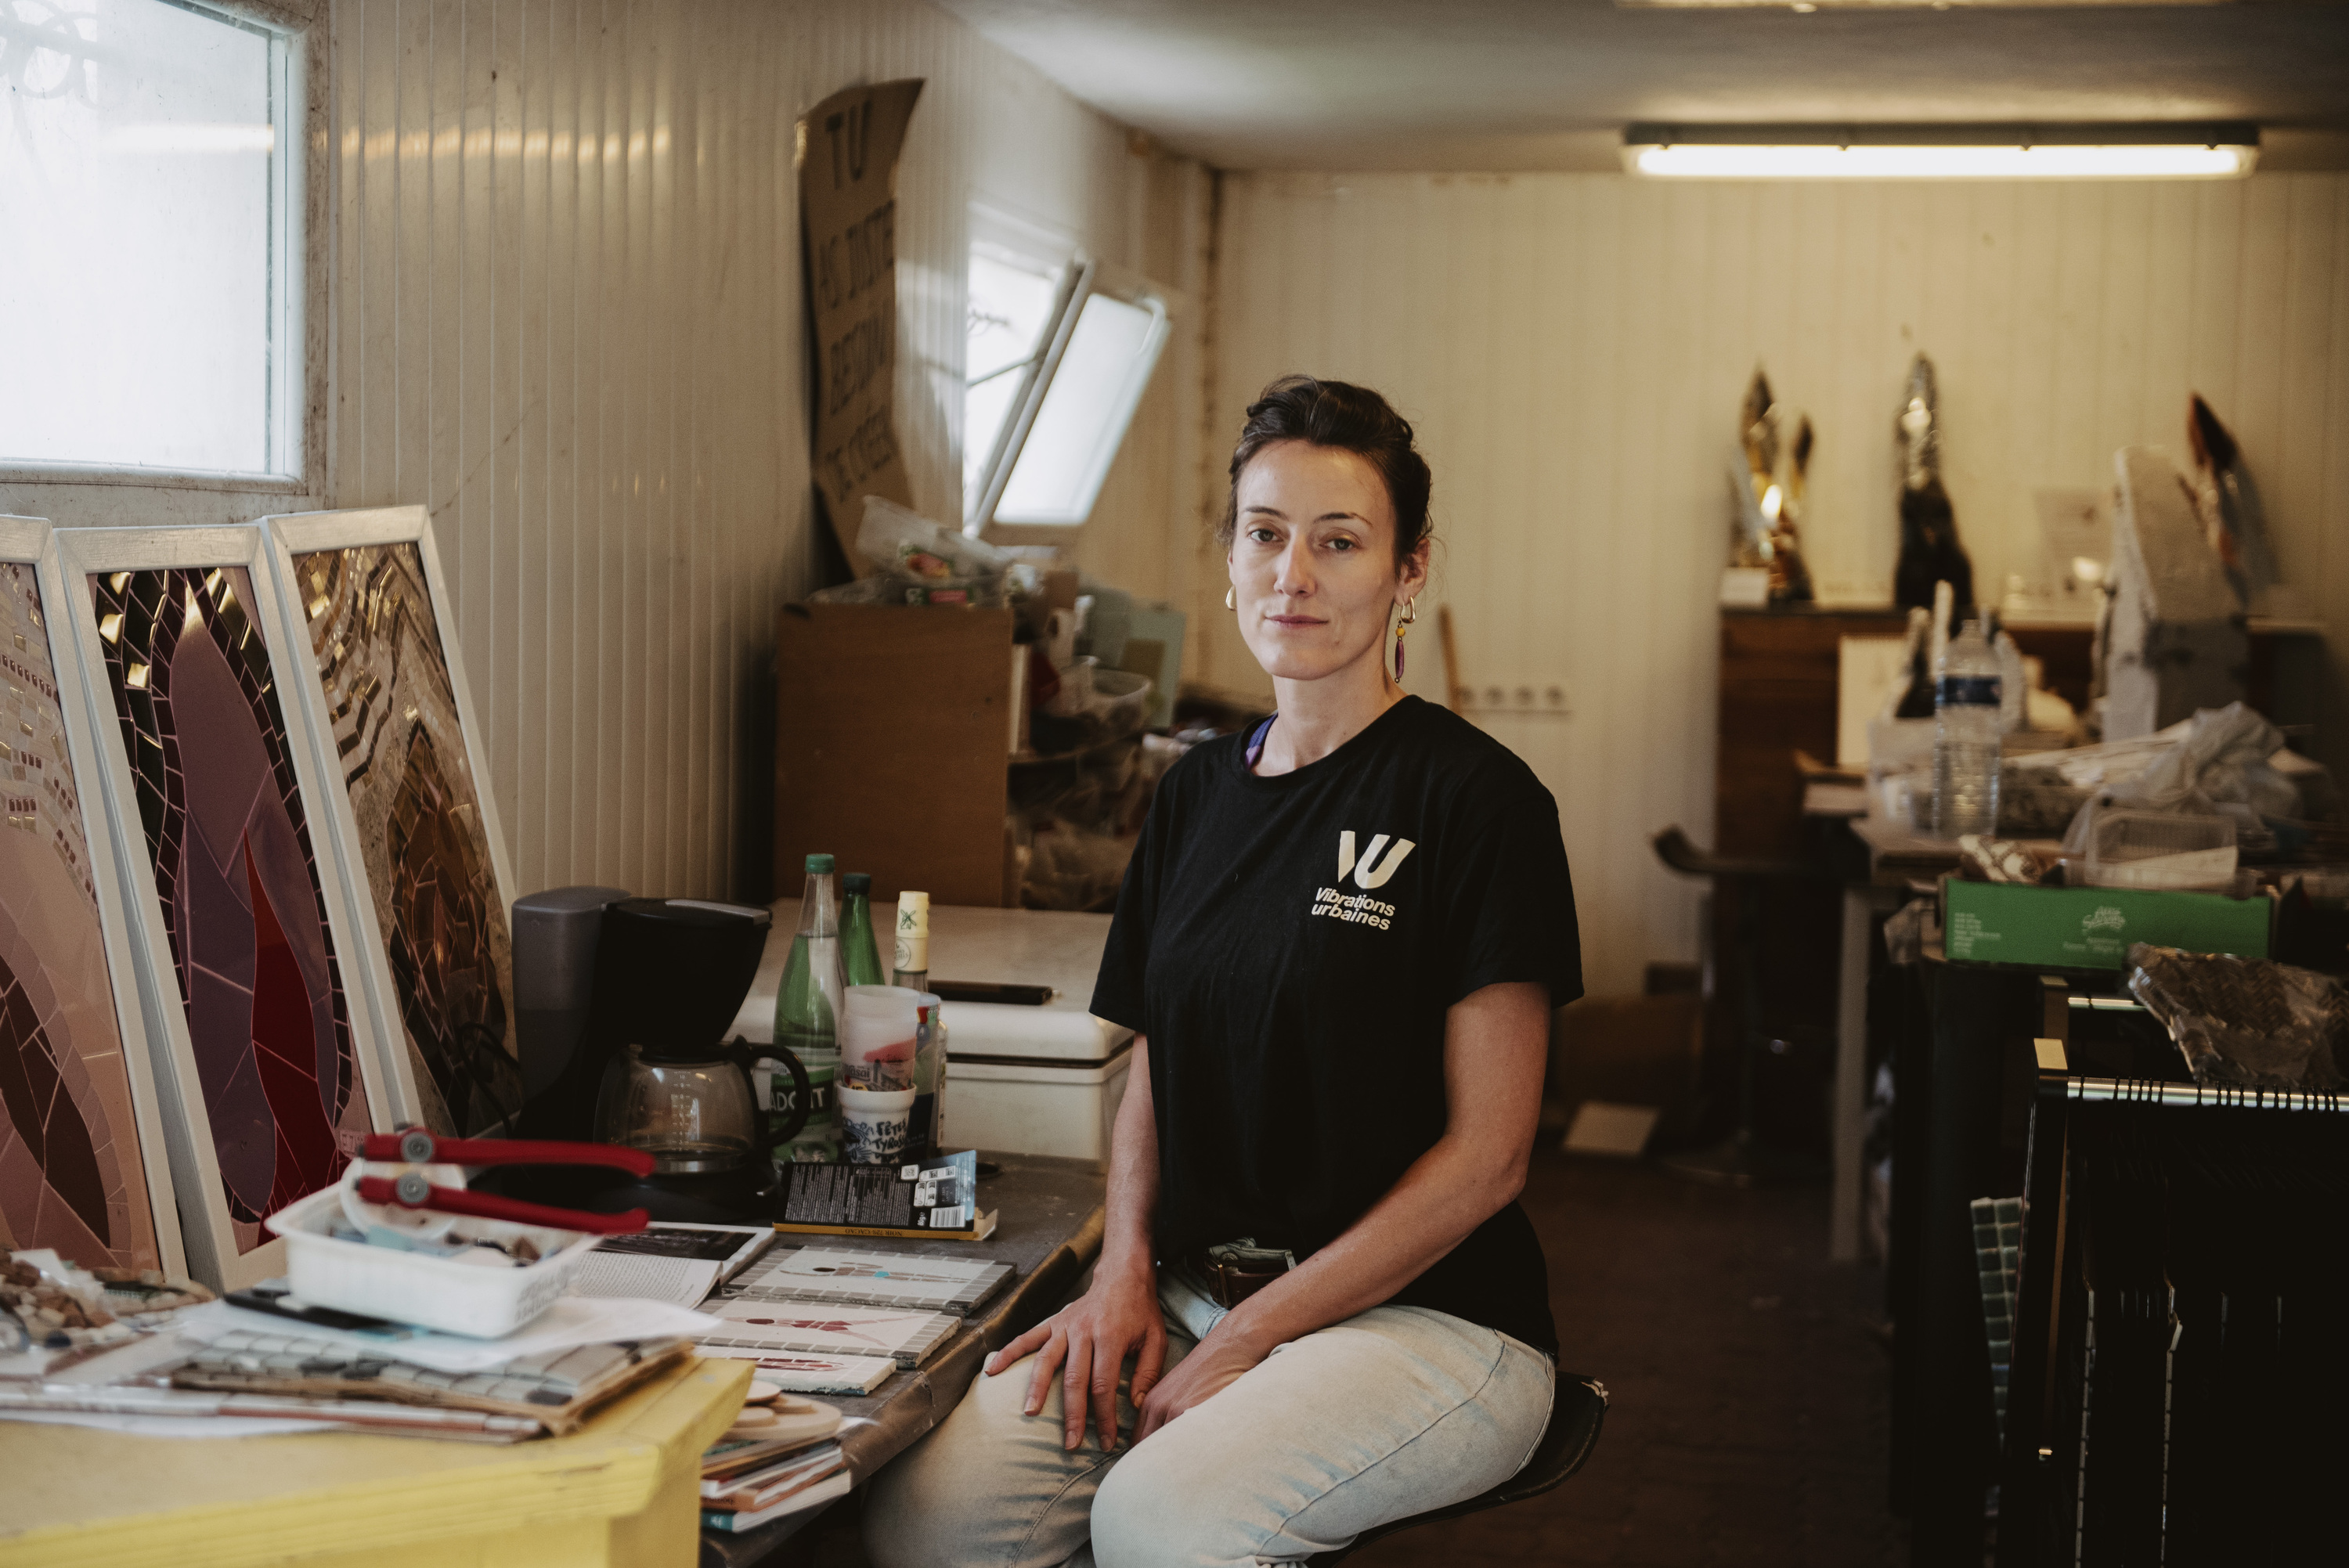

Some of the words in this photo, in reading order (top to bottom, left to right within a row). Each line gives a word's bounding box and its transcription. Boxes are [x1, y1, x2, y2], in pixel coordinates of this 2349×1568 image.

[825, 100, 872, 190] TU
[1311, 903, 1391, 931] urbaines
[1315, 887, 1396, 917] Vibrations
